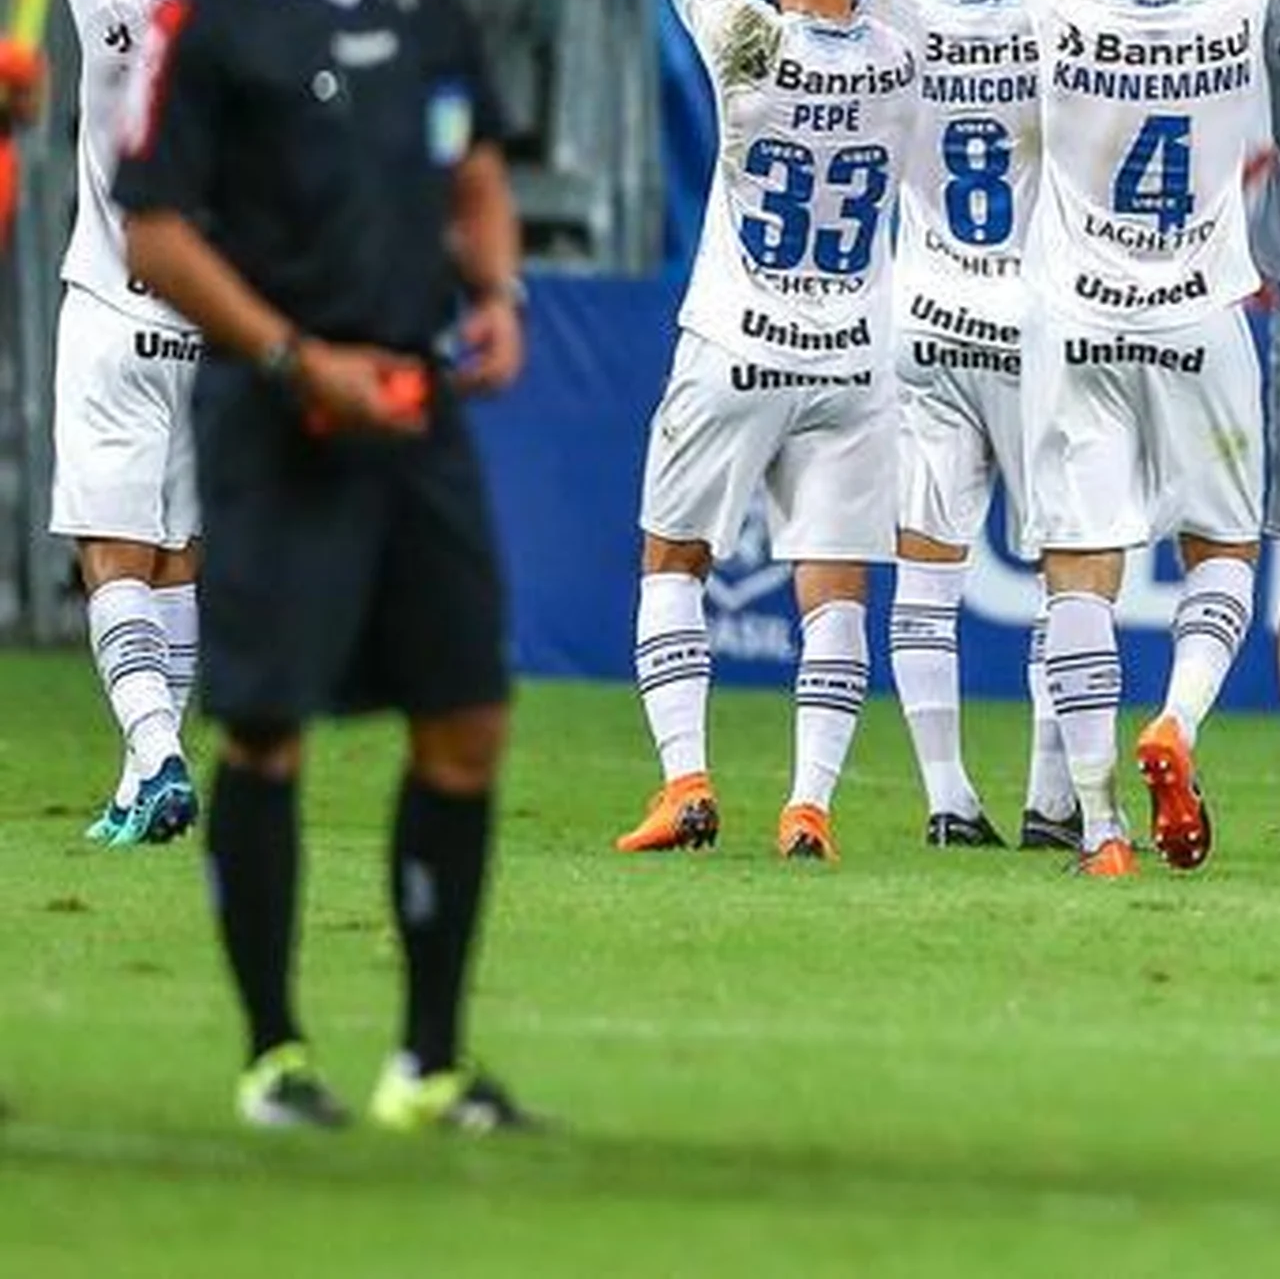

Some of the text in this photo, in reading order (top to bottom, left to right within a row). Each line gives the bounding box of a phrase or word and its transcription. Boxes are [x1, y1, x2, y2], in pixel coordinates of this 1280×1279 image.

[926, 32, 1040, 66] Banris
[1094, 18, 1251, 66] Banrisul
[775, 51, 915, 95] Banrisul
[922, 75, 1037, 105] MAICON
[1053, 60, 1251, 101] KANNEMANN
[943, 118, 1014, 246] 8
[1113, 115, 1194, 233] 4
[739, 138, 889, 276] 33
[741, 309, 871, 351] Unimed
[910, 295, 1020, 345] Unime
[912, 340, 1020, 376] Unime
[1064, 335, 1206, 375] Unimed
